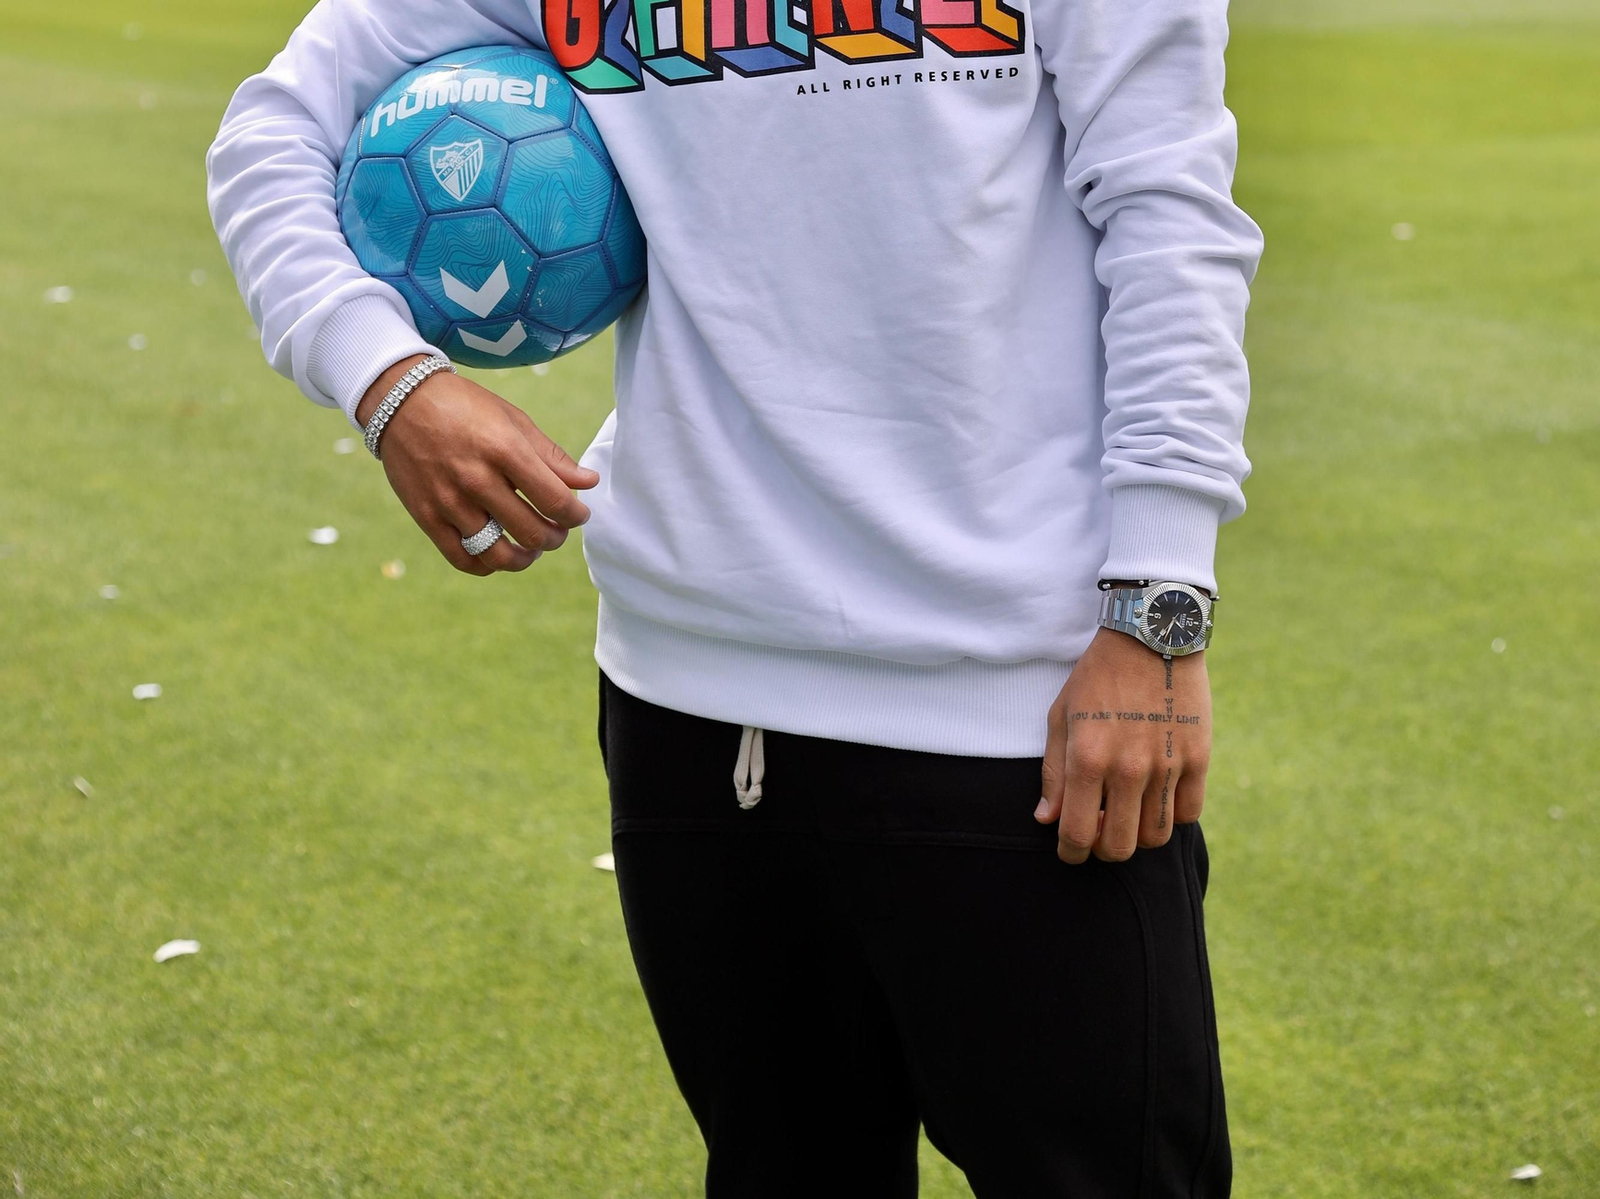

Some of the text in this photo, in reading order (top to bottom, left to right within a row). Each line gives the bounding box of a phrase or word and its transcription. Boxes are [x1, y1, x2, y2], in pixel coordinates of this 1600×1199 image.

[797, 67, 1019, 96] ALL RIGHT RESERVED
[1186, 617, 1194, 627] 12
[1070, 711, 1200, 725] YOU ARE YOUR ONLY LIMIT
